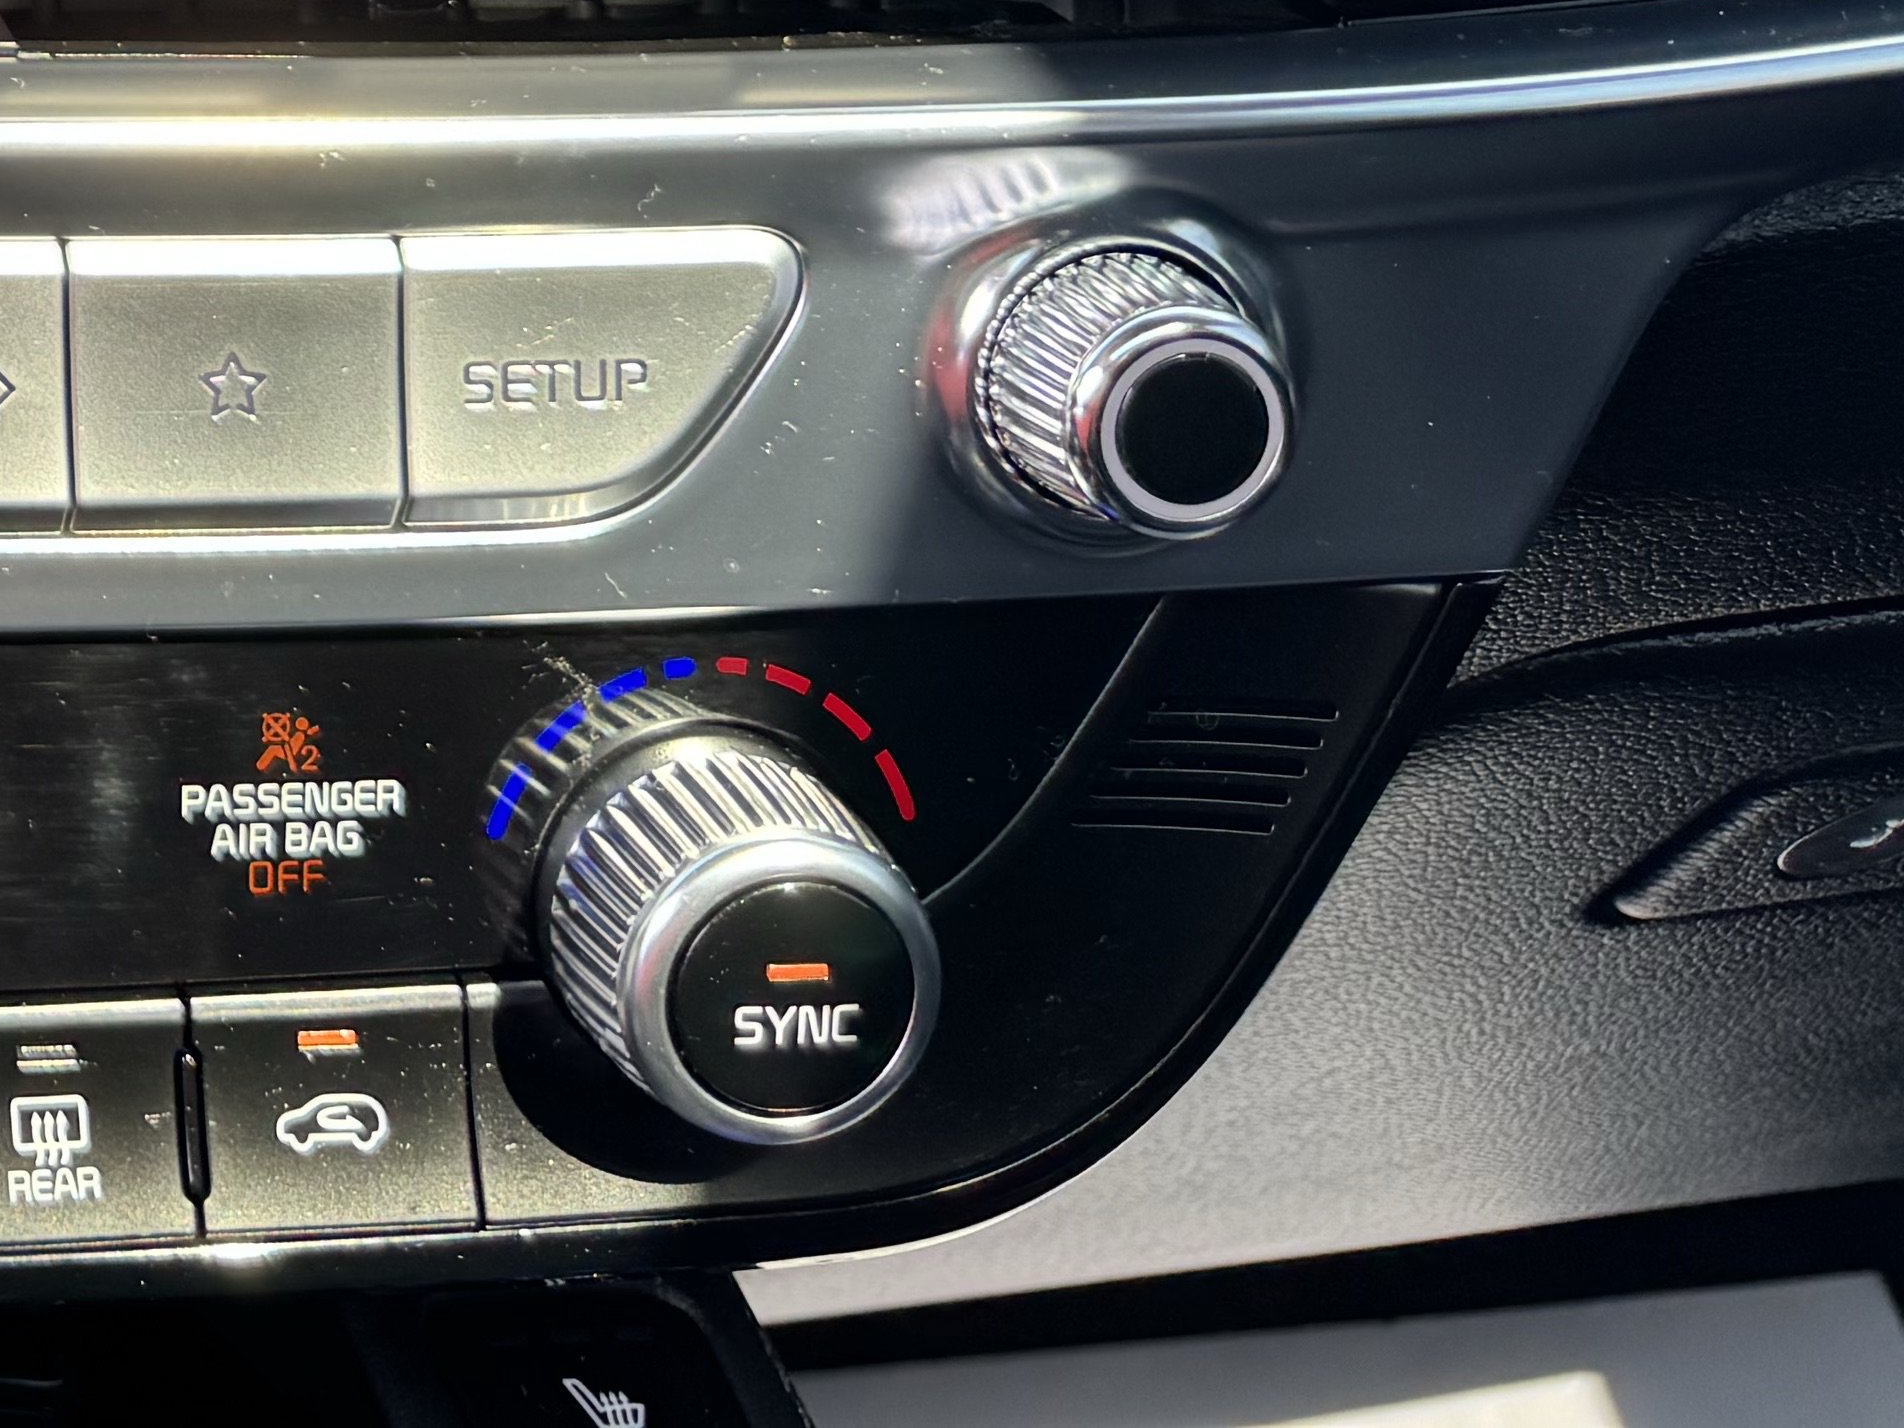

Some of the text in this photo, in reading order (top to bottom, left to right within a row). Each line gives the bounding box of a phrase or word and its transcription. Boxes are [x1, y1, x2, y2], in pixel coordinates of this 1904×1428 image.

[462, 356, 649, 404] SETUP
[181, 779, 407, 824] PASSENGER
[211, 820, 366, 862] AIR BAG
[249, 859, 327, 895] OFF
[734, 1004, 859, 1049] SYNC
[7, 1167, 104, 1206] REAR
